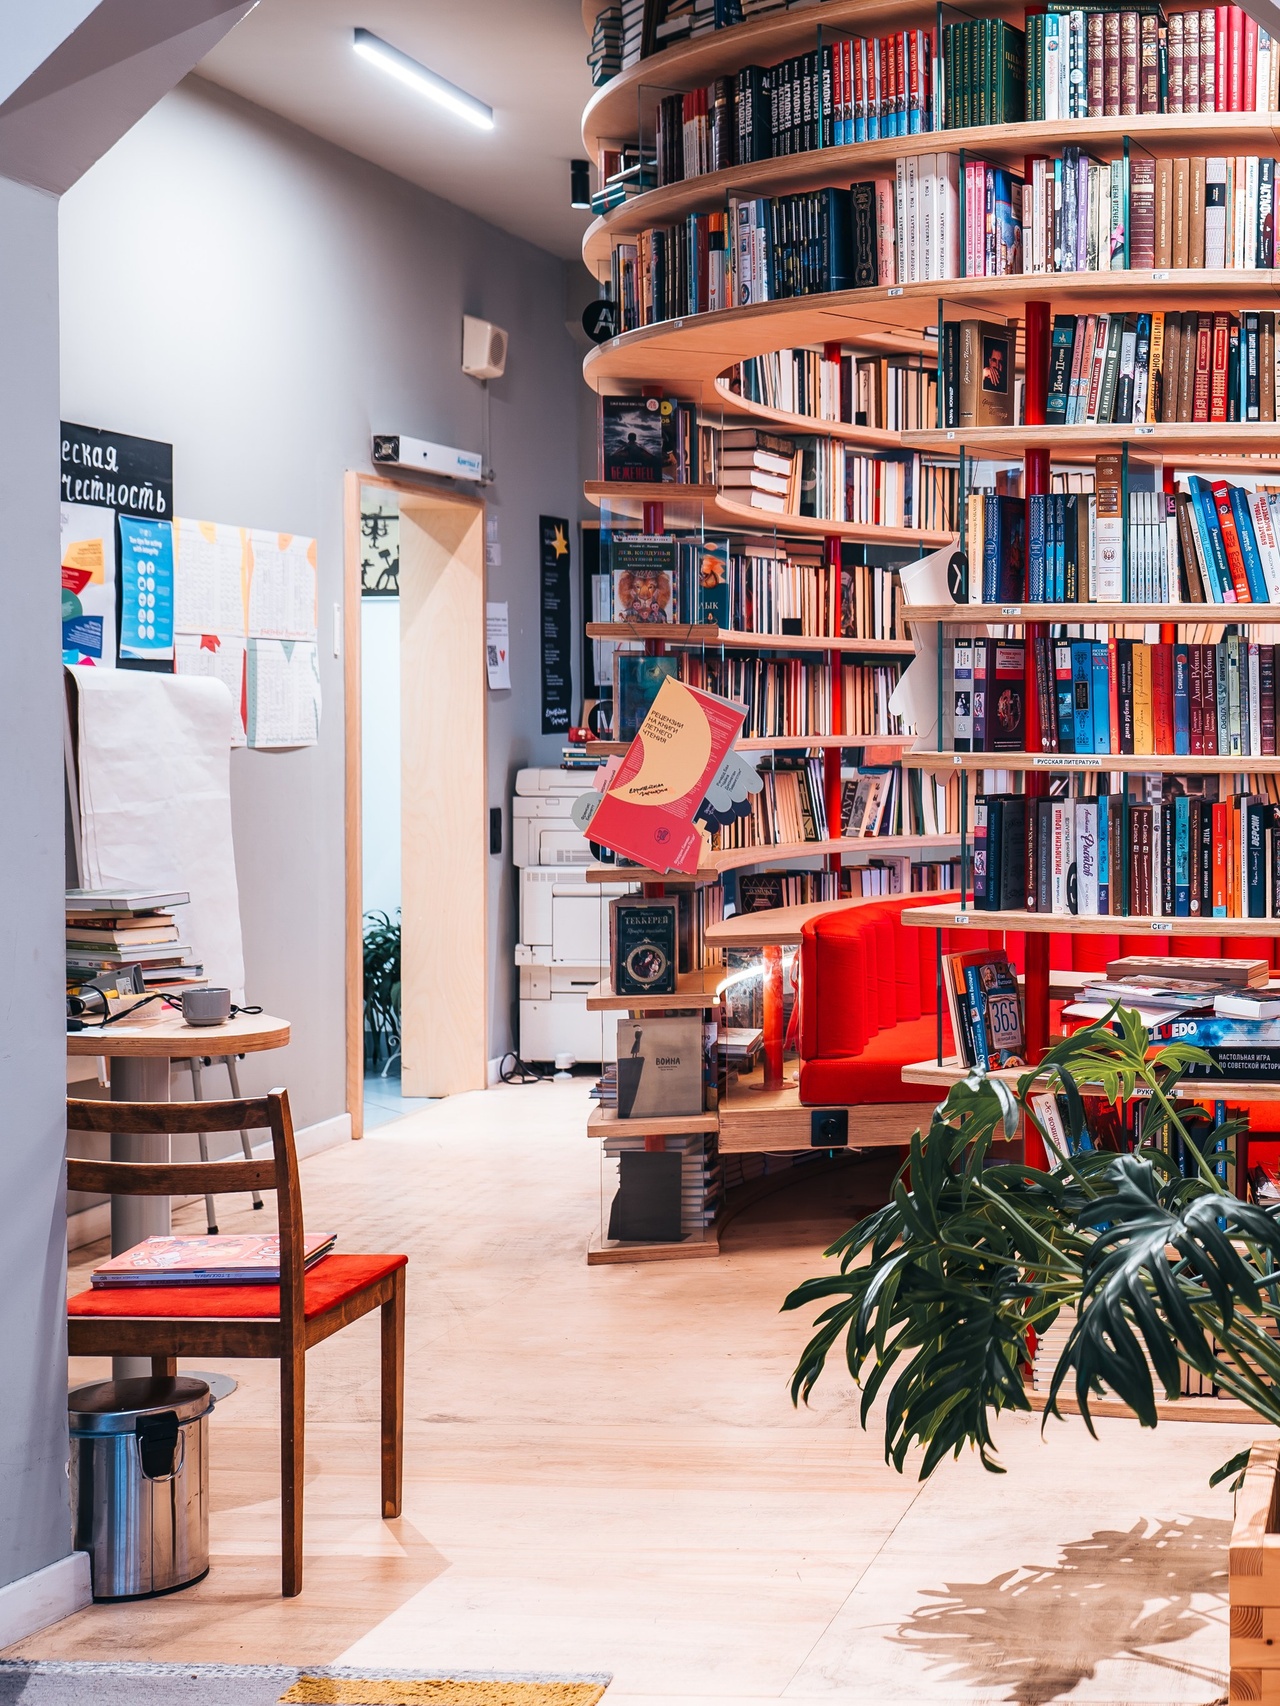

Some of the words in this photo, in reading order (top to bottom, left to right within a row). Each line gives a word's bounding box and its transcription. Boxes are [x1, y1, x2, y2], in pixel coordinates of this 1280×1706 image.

[793, 80, 801, 125] АСТАФЬЕВ
[822, 69, 831, 115] АСТАФЬЕВ
[1056, 349, 1065, 370] Петров
[1124, 342, 1132, 370] МАТИСС
[1053, 375, 1063, 392] Ильф
[1092, 363, 1100, 388] ИЛЬИНА
[1104, 360, 1115, 388] ИЛЬИНА
[1089, 390, 1098, 409] ЕЛЕНА
[1101, 391, 1110, 414] ЕЛЕНА
[61, 440, 119, 473] еская
[611, 466, 655, 481] БЕЖЕНЕЦ
[61, 473, 166, 513] честность
[1253, 501, 1263, 522] ГОТОВЫ,
[1259, 496, 1272, 531] ВЫСОЧЕСТВО!
[1257, 523, 1268, 546] БУДЬТЕ
[1267, 532, 1276, 548] ВАШЕ
[1190, 650, 1202, 678] Рубина
[1203, 650, 1214, 678] Рубина
[1192, 679, 1201, 702] Дина
[1205, 679, 1214, 702] Дина
[644, 722, 673, 739] ЛЕТНЕГО
[648, 716, 658, 725] НА
[657, 720, 678, 734] КНИГИ
[650, 709, 684, 729] РЕЦЕНЗИИ
[1220, 706, 1228, 754] ХЛОРОФИЛИЯ
[642, 729, 667, 744] ЧТЕНИЯ
[1054, 810, 1062, 830] КРОША
[1193, 819, 1198, 829] XX
[1251, 814, 1260, 846] ВЕРСИИ
[1054, 831, 1062, 875] ПРИКЛЮЧЕНИЯ
[1080, 834, 1095, 877] Рыбаков
[624, 916, 668, 925] ТЕККЕРЕЙ
[992, 1002, 1018, 1033] 365
[1148, 1021, 1198, 1041] CLUEDO
[655, 1056, 681, 1066] ВОЙНА
[1218, 1052, 1256, 1061] НАСТОЛЬНАЯ
[1257, 1054, 1271, 1062] ИГРА
[1227, 1061, 1260, 1070] СОВЕТСКОЙ
